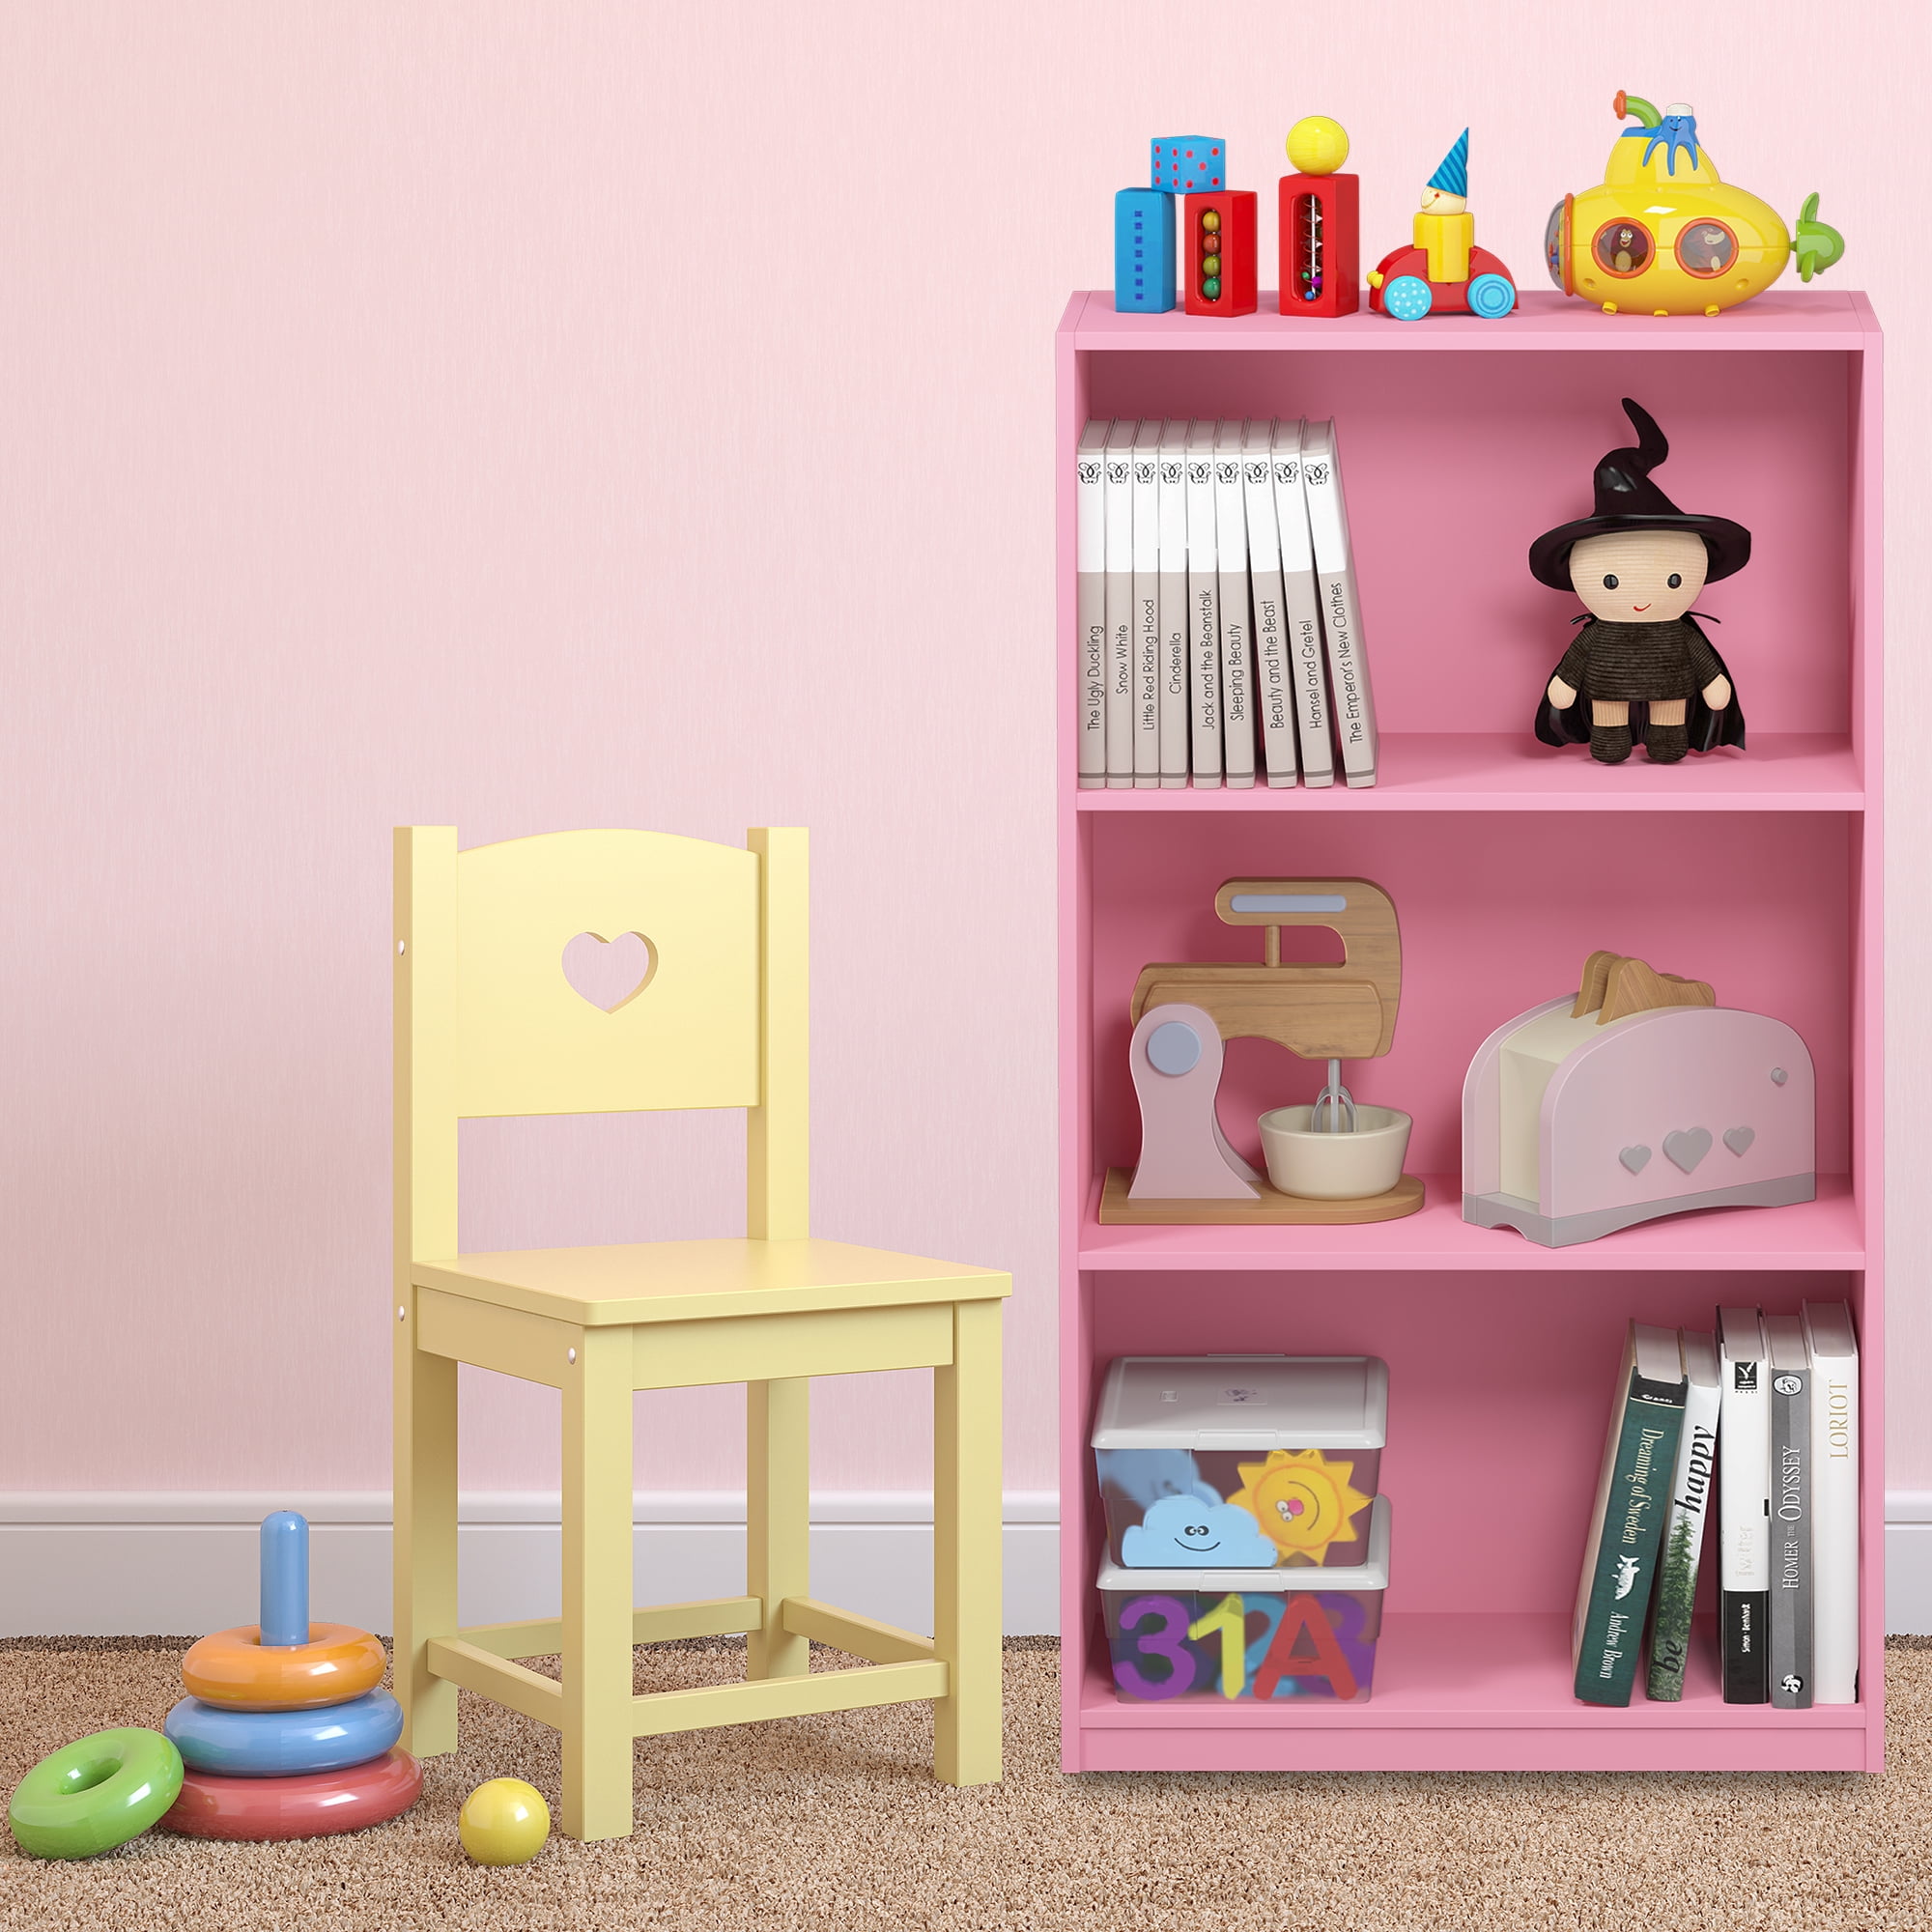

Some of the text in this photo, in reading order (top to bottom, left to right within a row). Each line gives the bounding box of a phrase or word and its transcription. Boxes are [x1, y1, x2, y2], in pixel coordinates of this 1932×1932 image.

[1087, 625, 1103, 730] The Ugly Duckling
[1116, 625, 1128, 694] Snow White
[1143, 600, 1157, 729] Little Red Riding Hood
[1169, 633, 1181, 694] Cinderella
[1200, 590, 1214, 729] Jack and the Beanstalk
[1228, 624, 1244, 721] Sleeping Beauty
[1261, 601, 1284, 728] Beauty and the Beast
[1299, 620, 1322, 729] Hansel and Gretel
[1330, 582, 1362, 744] The Emperor's New Clothes
[1624, 1428, 1664, 1485] Dreaming
[1829, 1379, 1848, 1459] LORIOT
[1622, 1499, 1651, 1545] Sweden
[1630, 1486, 1652, 1502] of
[1777, 1445, 1801, 1521] ODYSSEY
[1653, 1425, 1716, 1674] be happy
[1782, 1541, 1799, 1589] HOMER
[1599, 1610, 1630, 1679] Andrew Brown
